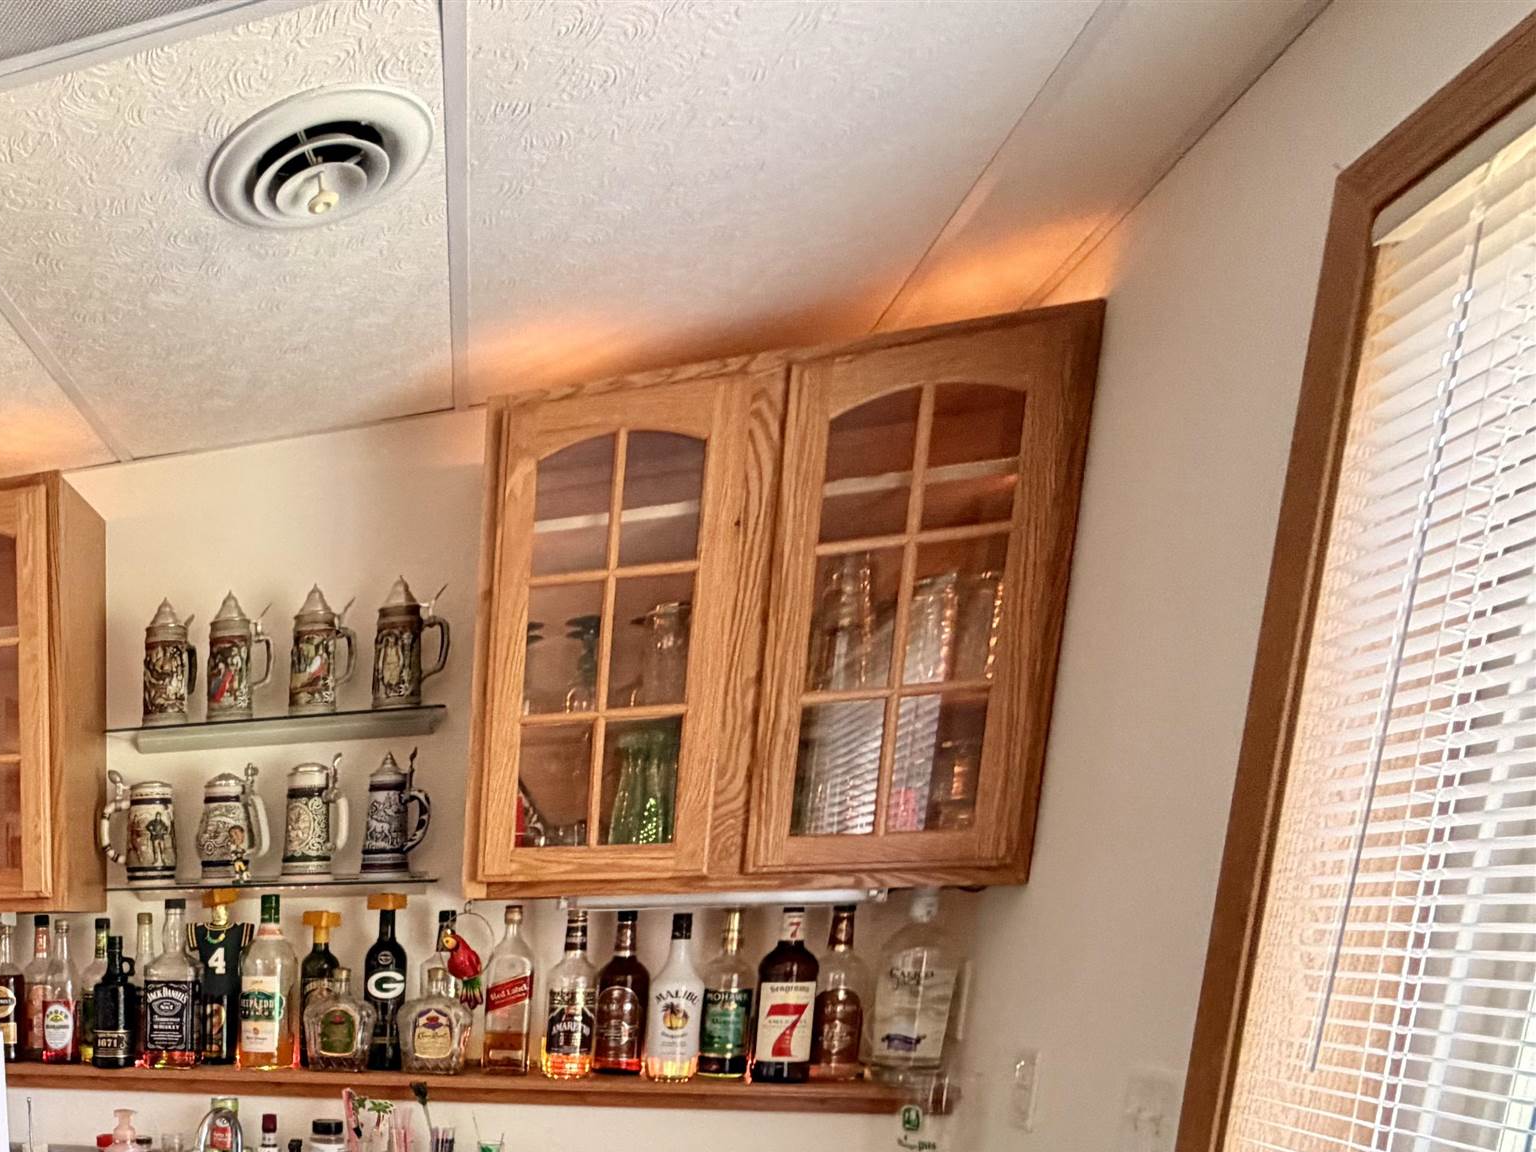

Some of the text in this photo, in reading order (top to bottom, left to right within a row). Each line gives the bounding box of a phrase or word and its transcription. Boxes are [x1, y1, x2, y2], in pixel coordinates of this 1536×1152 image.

[789, 921, 801, 938] 7
[208, 947, 226, 974] 4
[506, 983, 529, 996] Label
[655, 989, 699, 1004] MALIBU
[766, 1003, 810, 1057] 7
